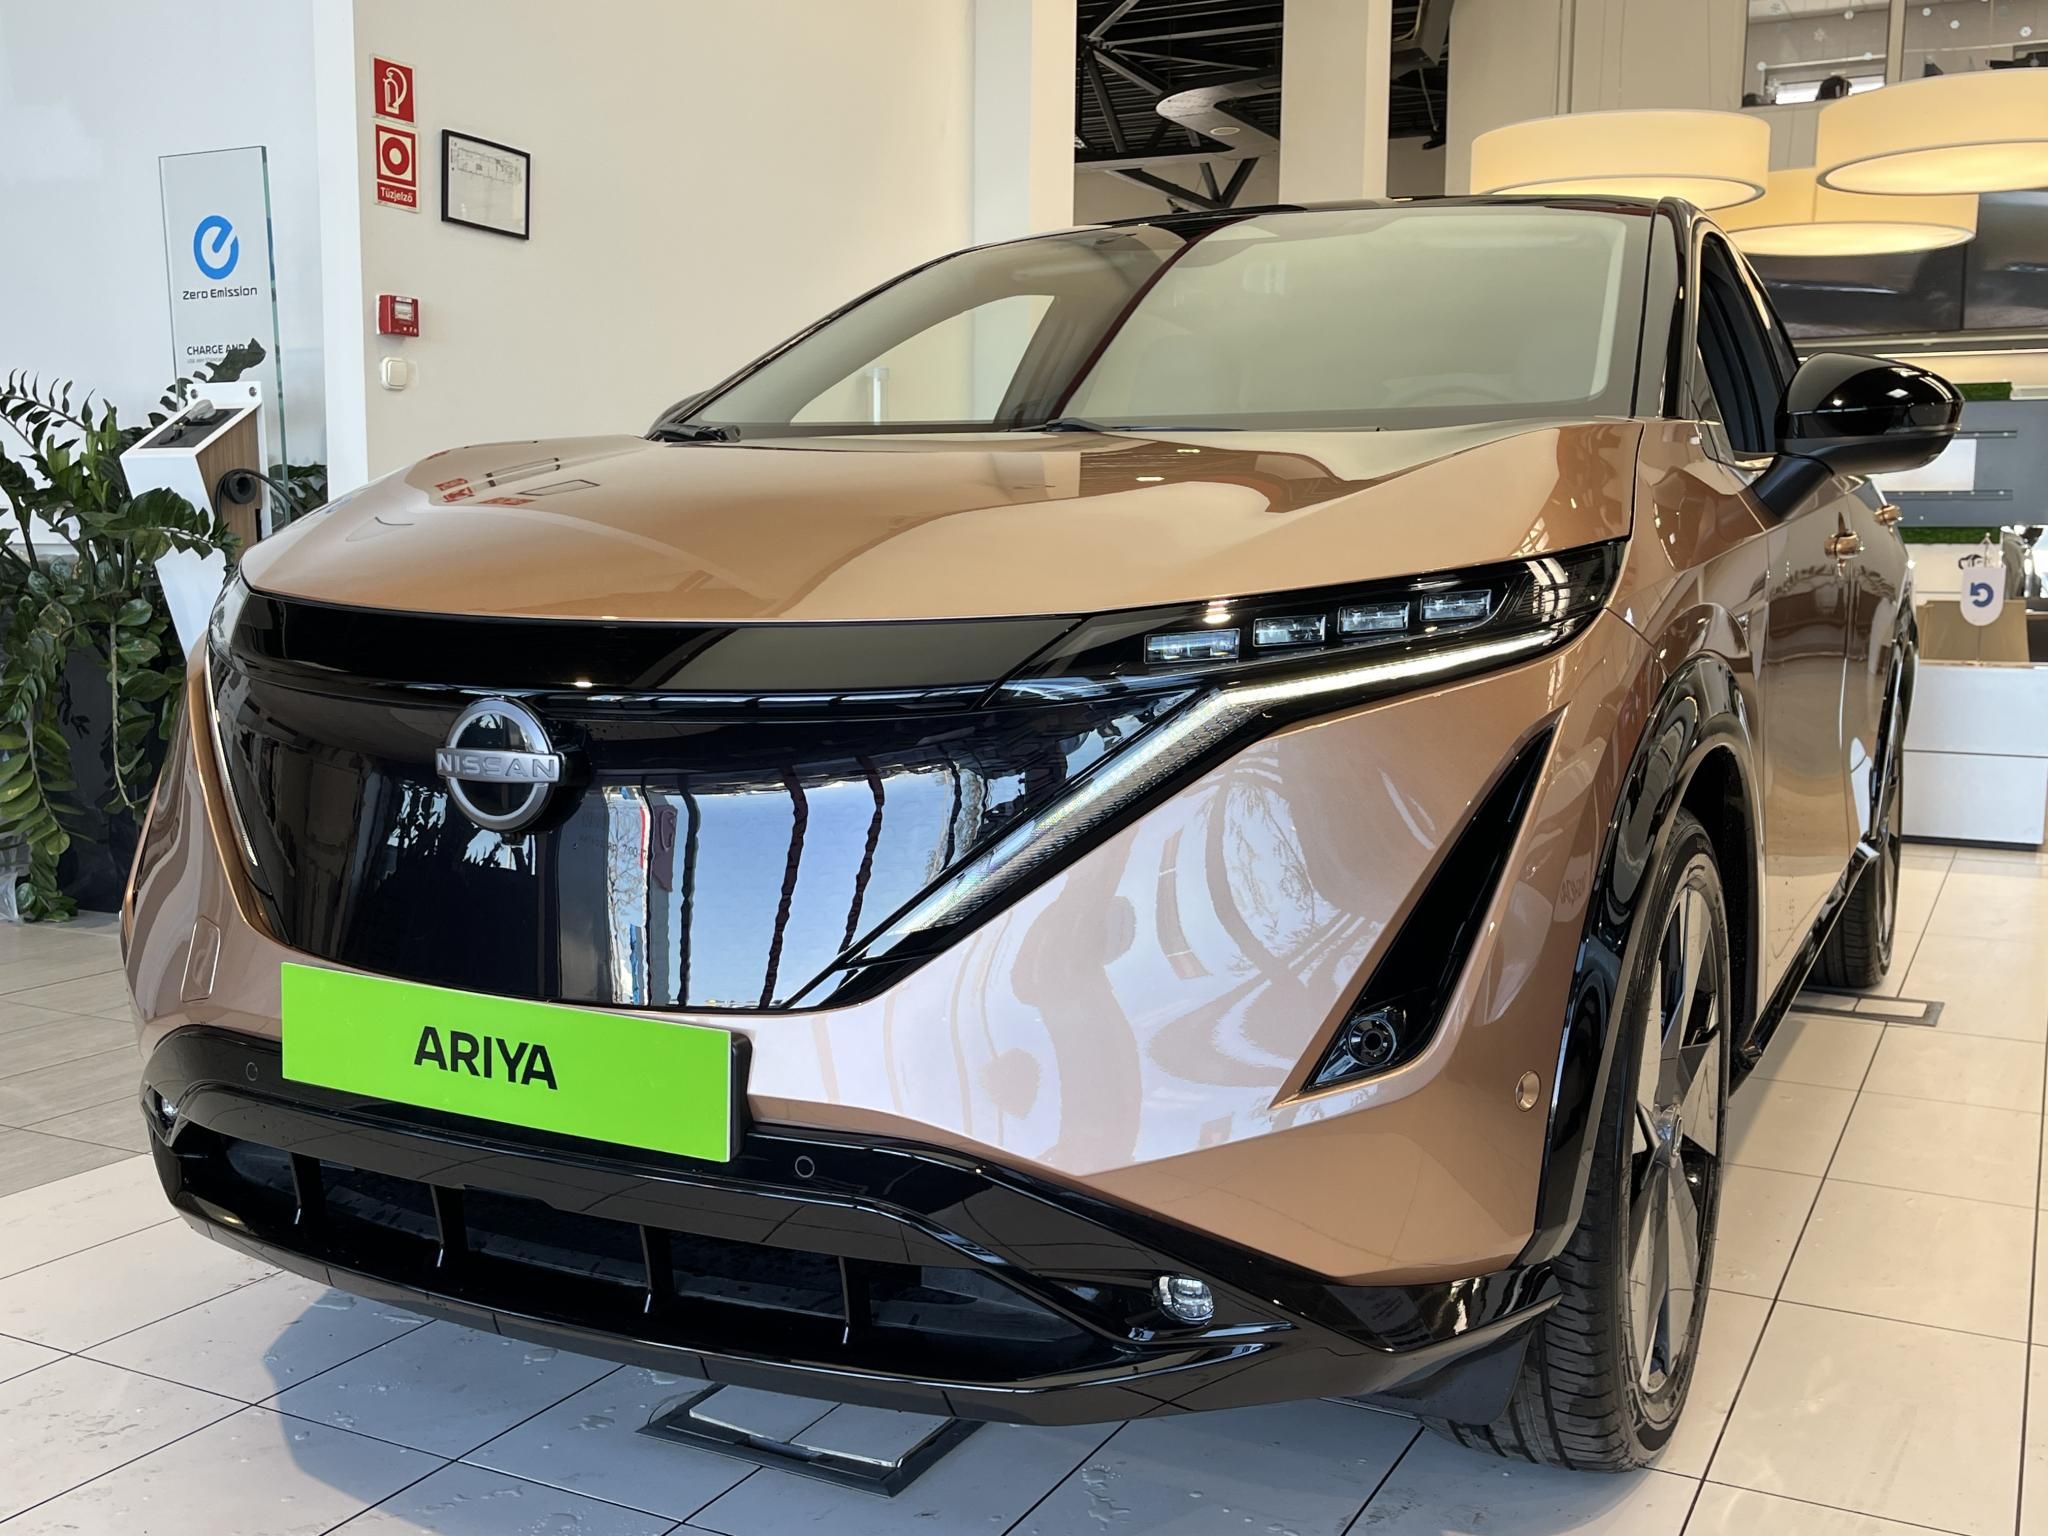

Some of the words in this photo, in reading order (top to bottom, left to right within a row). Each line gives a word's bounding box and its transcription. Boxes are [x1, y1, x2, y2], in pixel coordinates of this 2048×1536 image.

[182, 290, 208, 300] Zero
[210, 286, 257, 298] Emission
[186, 345, 223, 355] CHARGE
[436, 752, 556, 779] NISSAN
[413, 1025, 558, 1090] ARIYA
